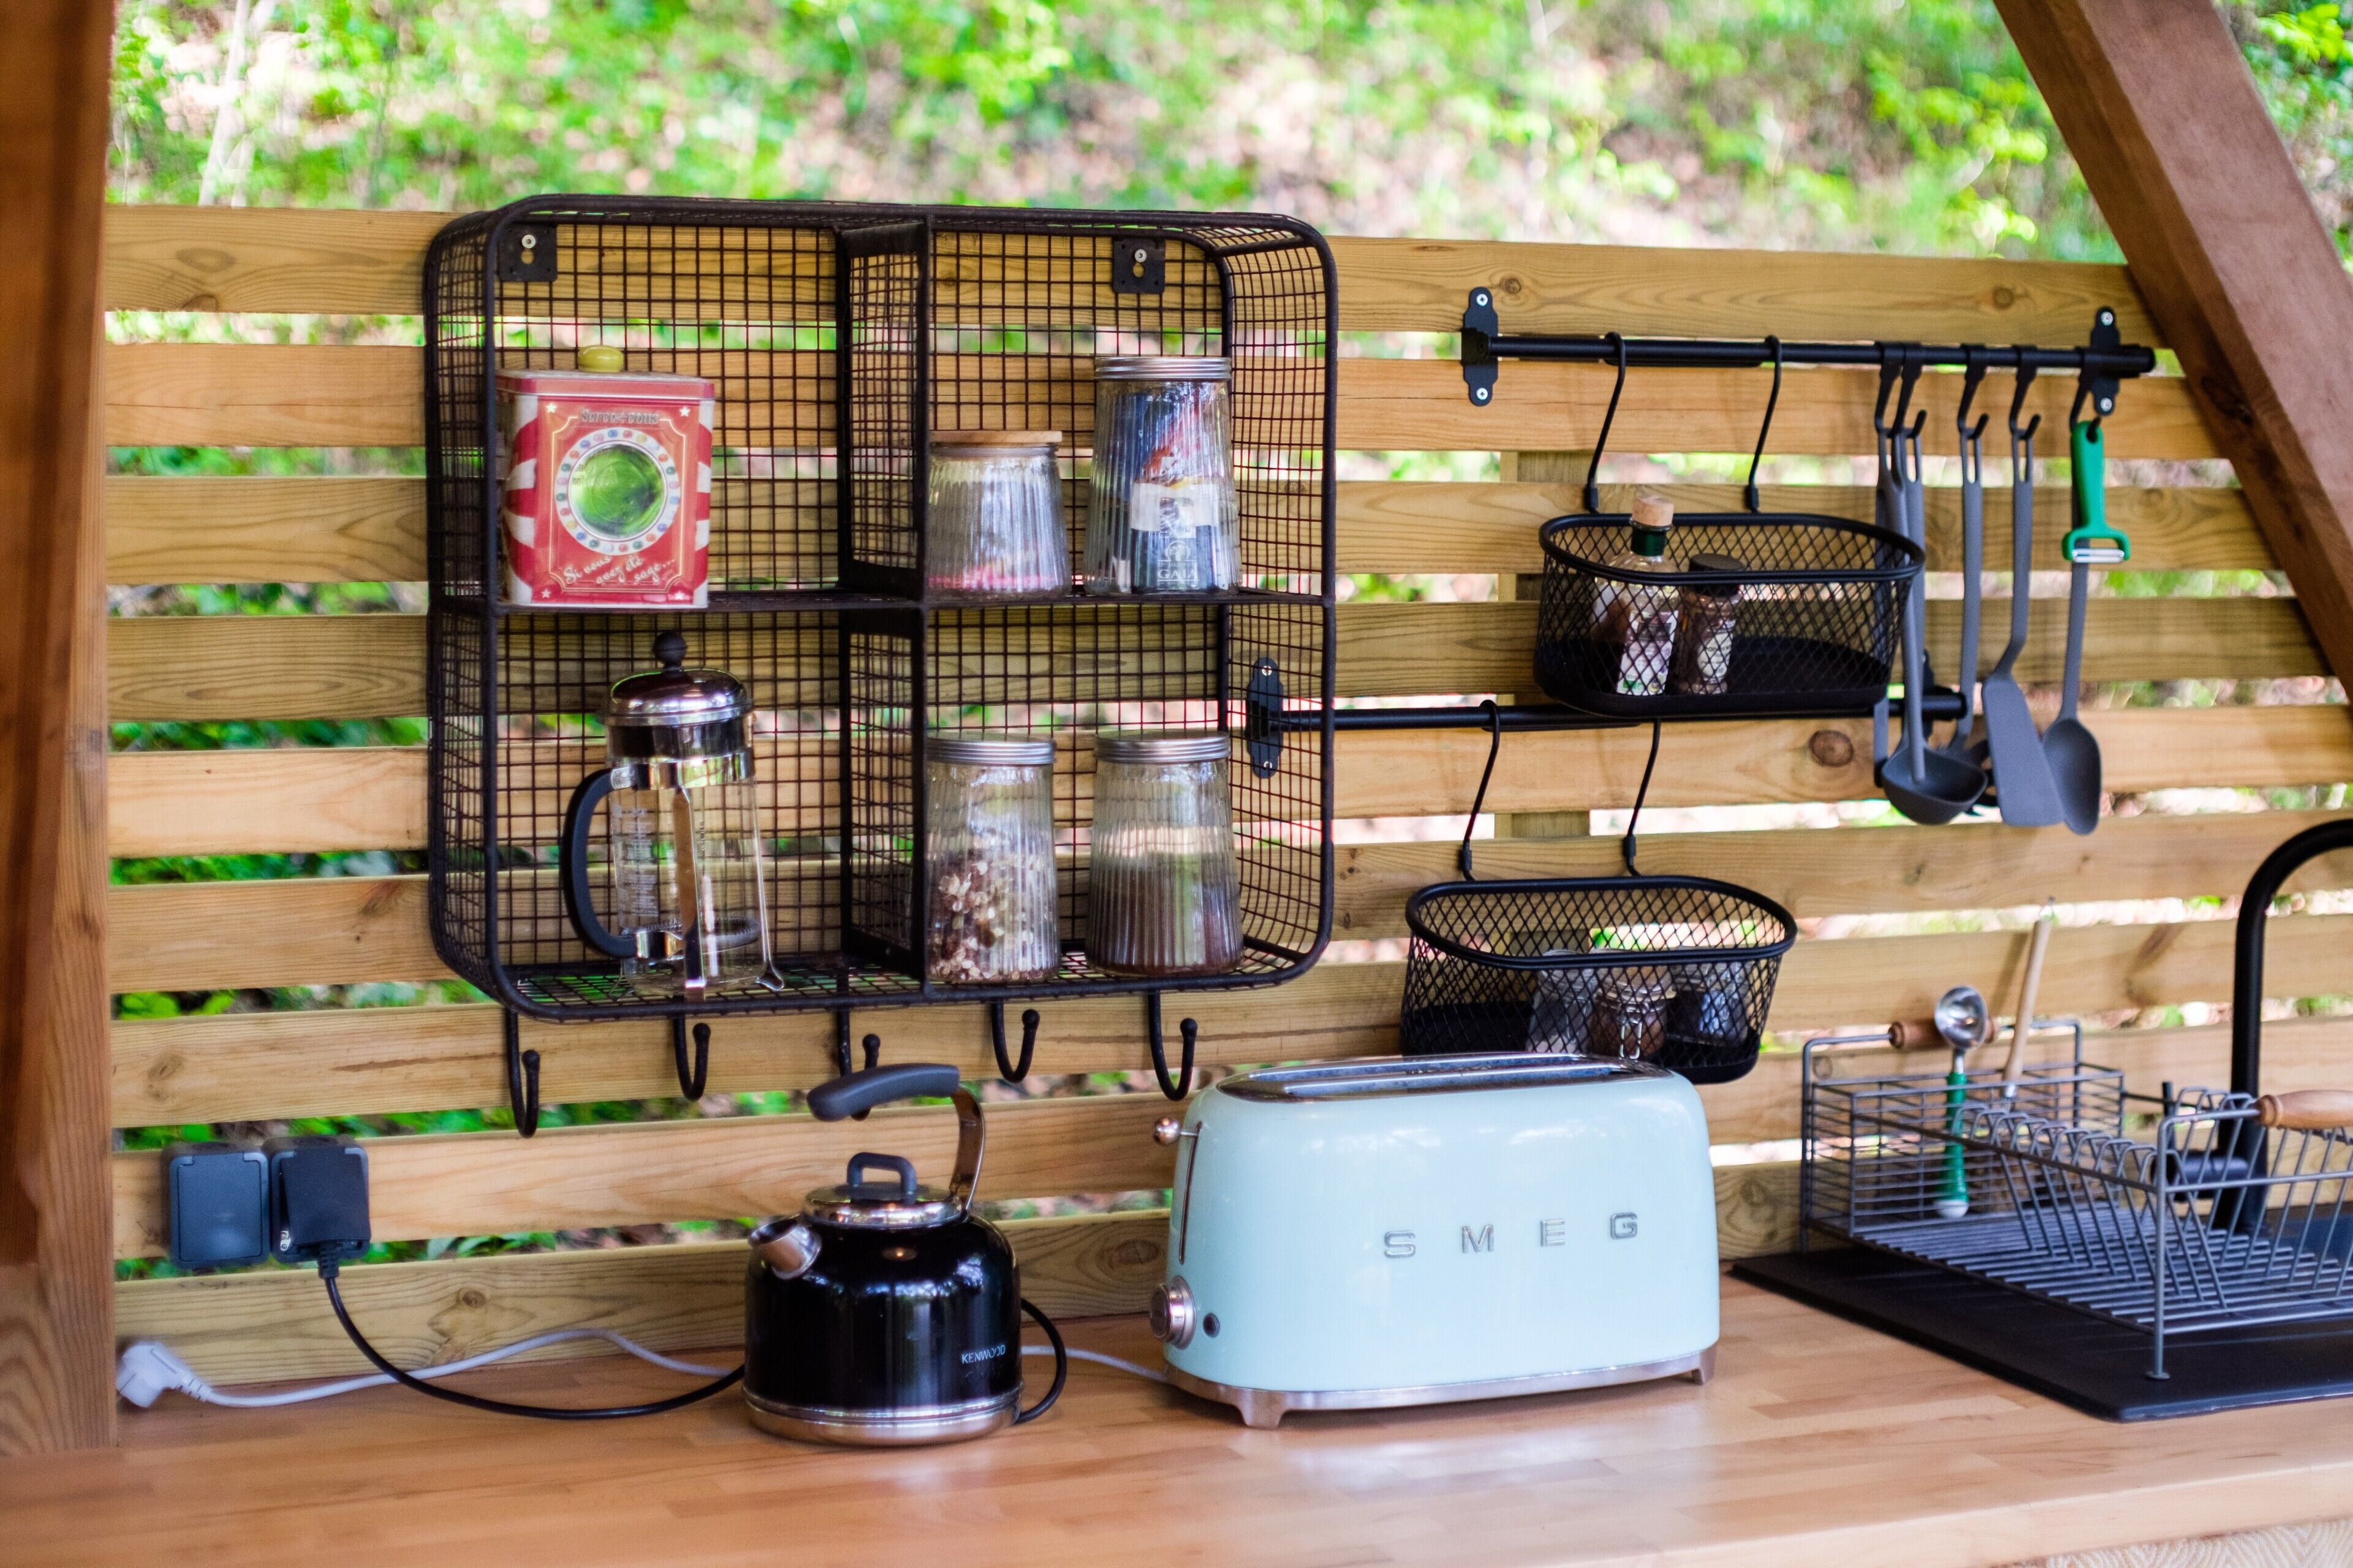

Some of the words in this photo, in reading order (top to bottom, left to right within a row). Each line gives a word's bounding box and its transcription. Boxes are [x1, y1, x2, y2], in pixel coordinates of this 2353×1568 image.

[563, 564, 582, 584] Si
[584, 555, 612, 574] vous
[596, 566, 625, 583] avez
[1384, 1211, 1638, 1259] SMEG
[961, 1344, 1006, 1363] KENWOOD
